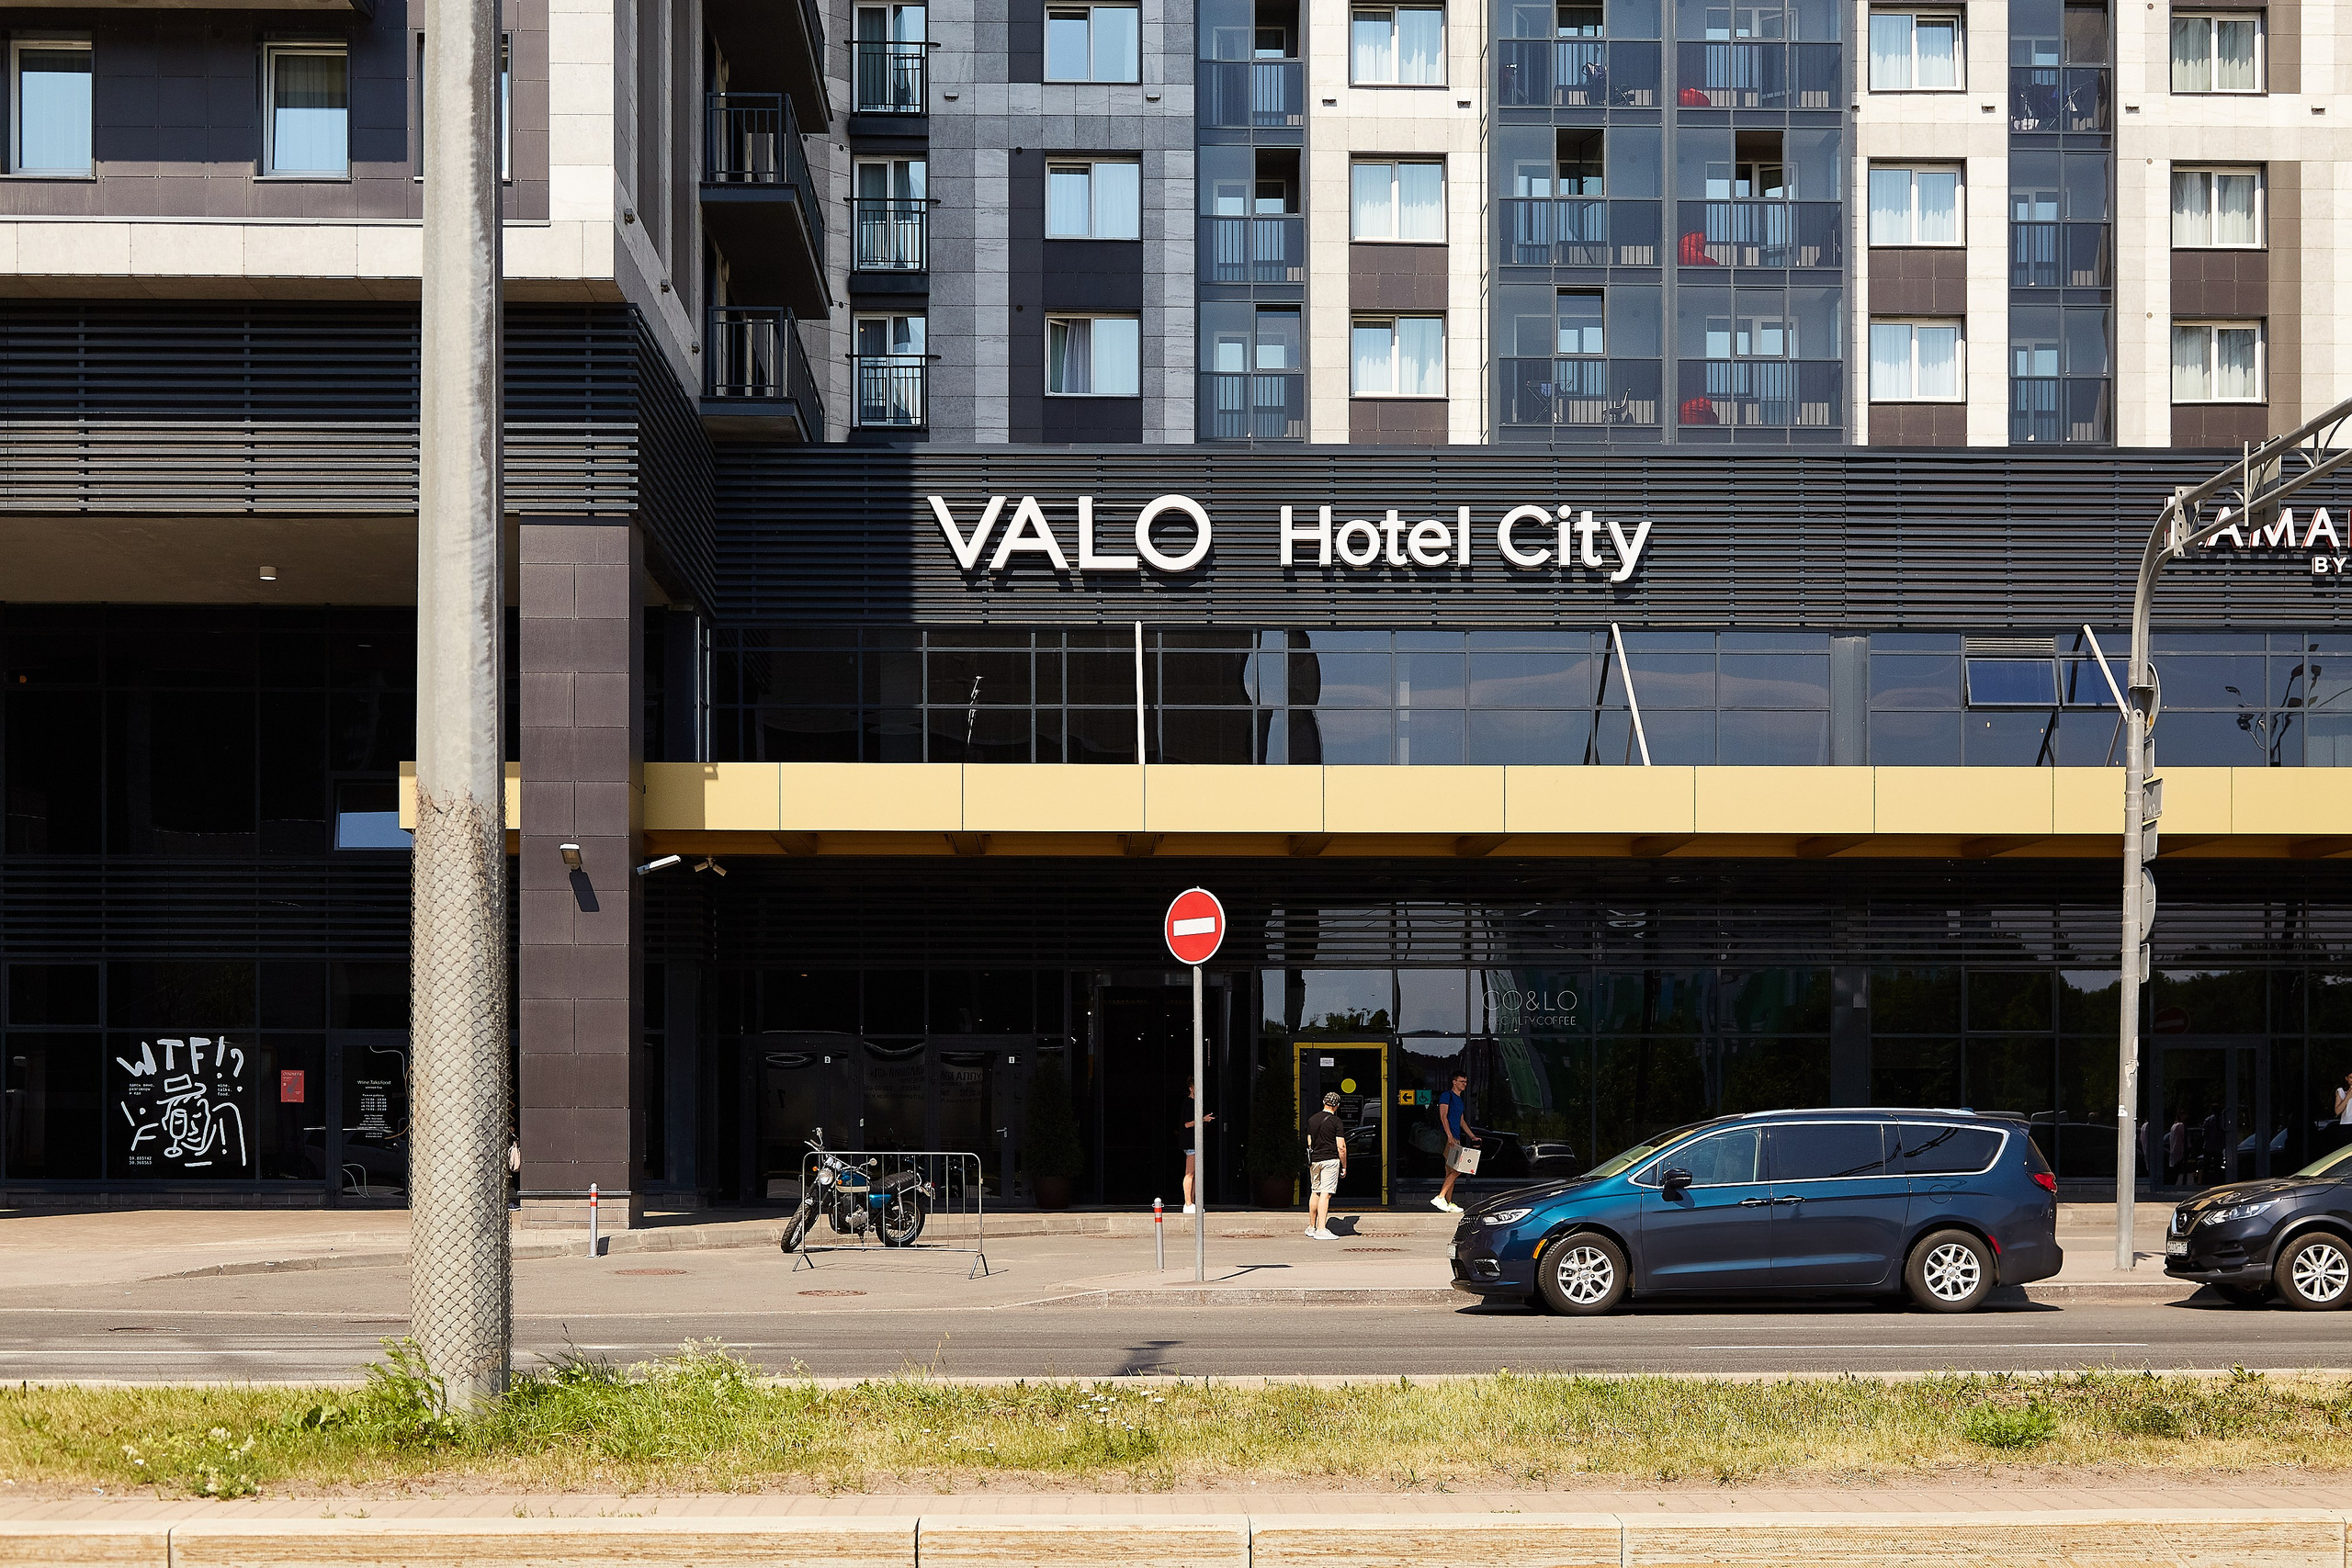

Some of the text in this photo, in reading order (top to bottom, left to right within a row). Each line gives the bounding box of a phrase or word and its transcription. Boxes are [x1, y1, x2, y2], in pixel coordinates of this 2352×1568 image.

[926, 493, 1654, 585] VALO Hotel City
[2164, 496, 2352, 549] AMA
[2312, 557, 2347, 575] BY
[1482, 989, 1578, 1011] CO&LO
